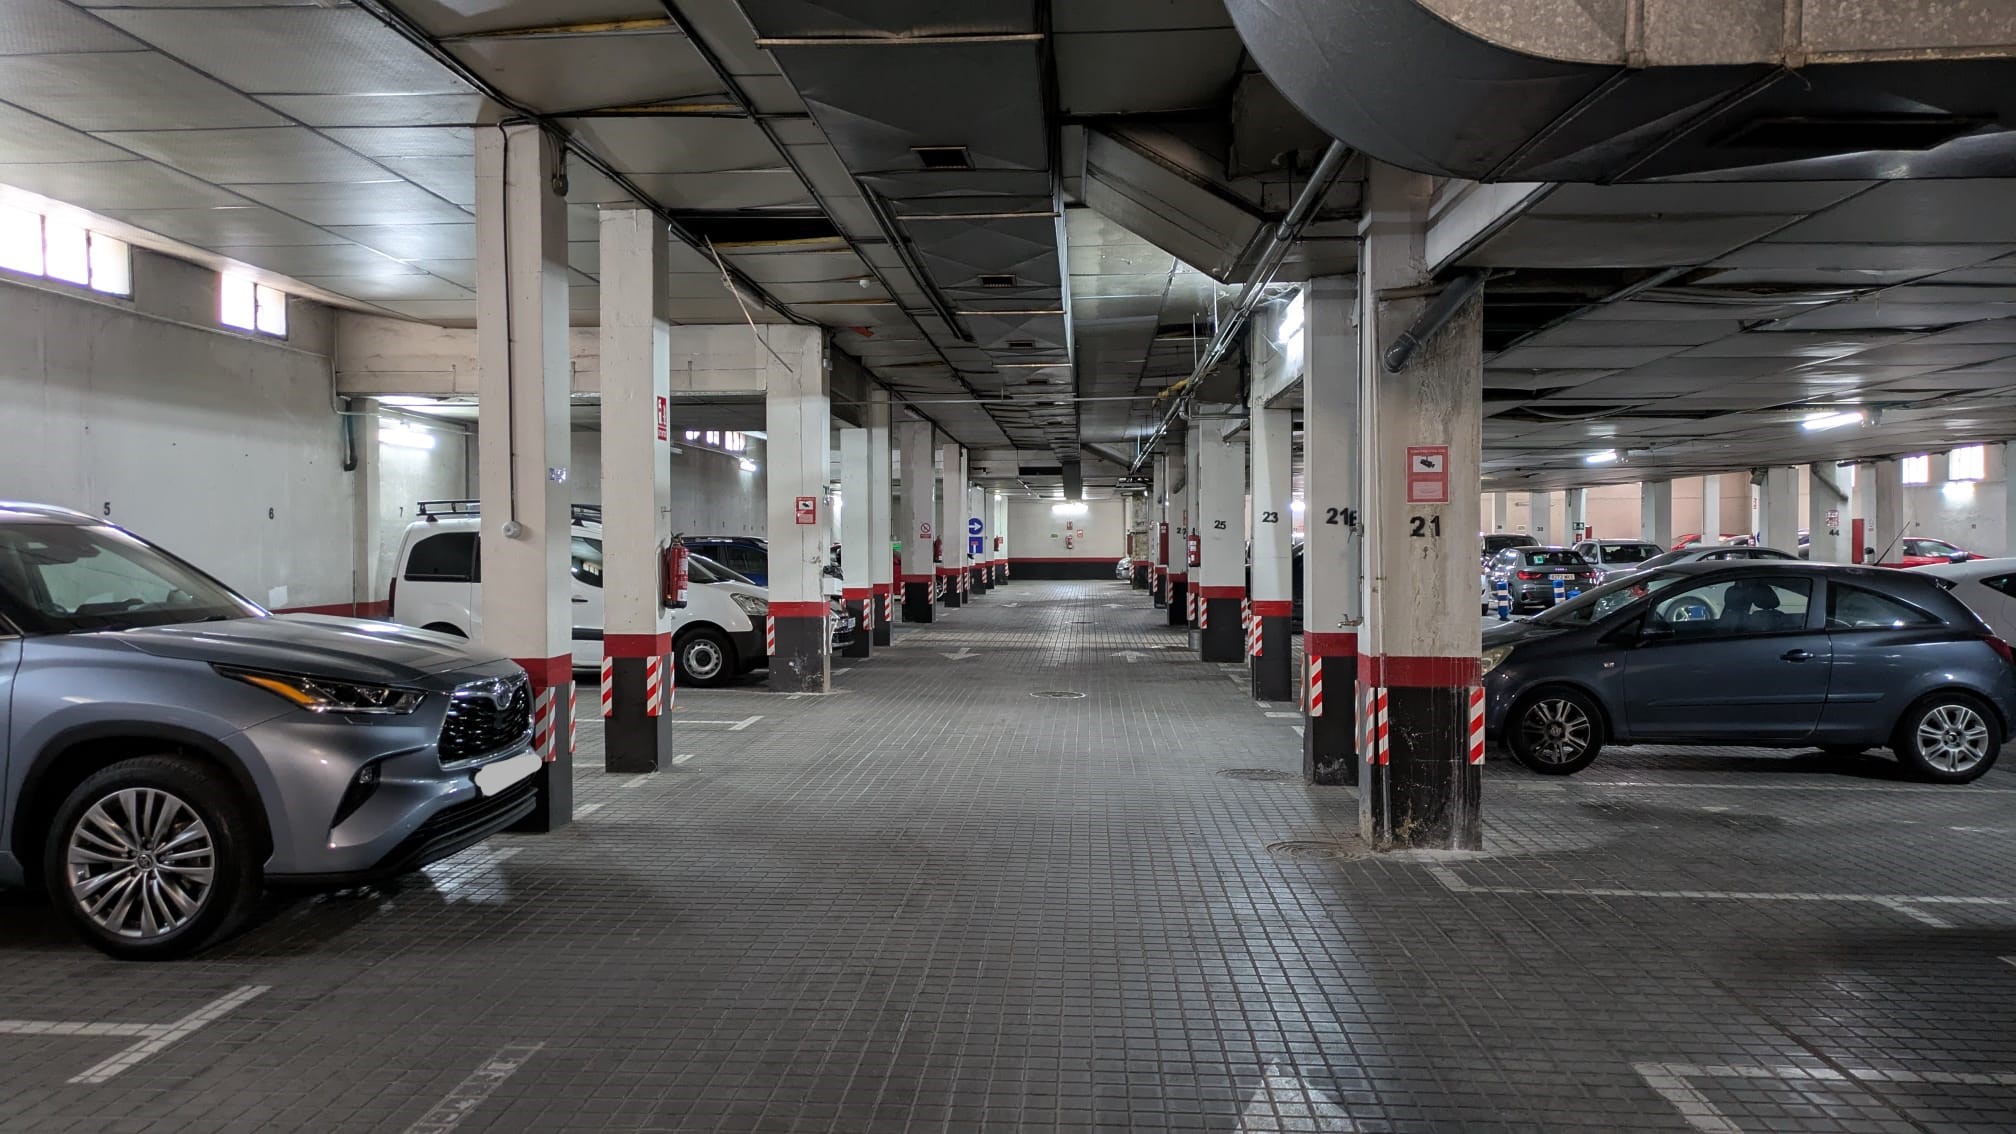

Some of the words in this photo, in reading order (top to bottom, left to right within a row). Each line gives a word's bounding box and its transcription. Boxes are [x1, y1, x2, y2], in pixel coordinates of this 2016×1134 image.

[103, 501, 111, 516] 5
[268, 507, 275, 520] 6
[1262, 511, 1279, 523] 23
[1214, 519, 1227, 530] 25
[1409, 515, 1441, 537] 21
[1828, 529, 1840, 537] 44
